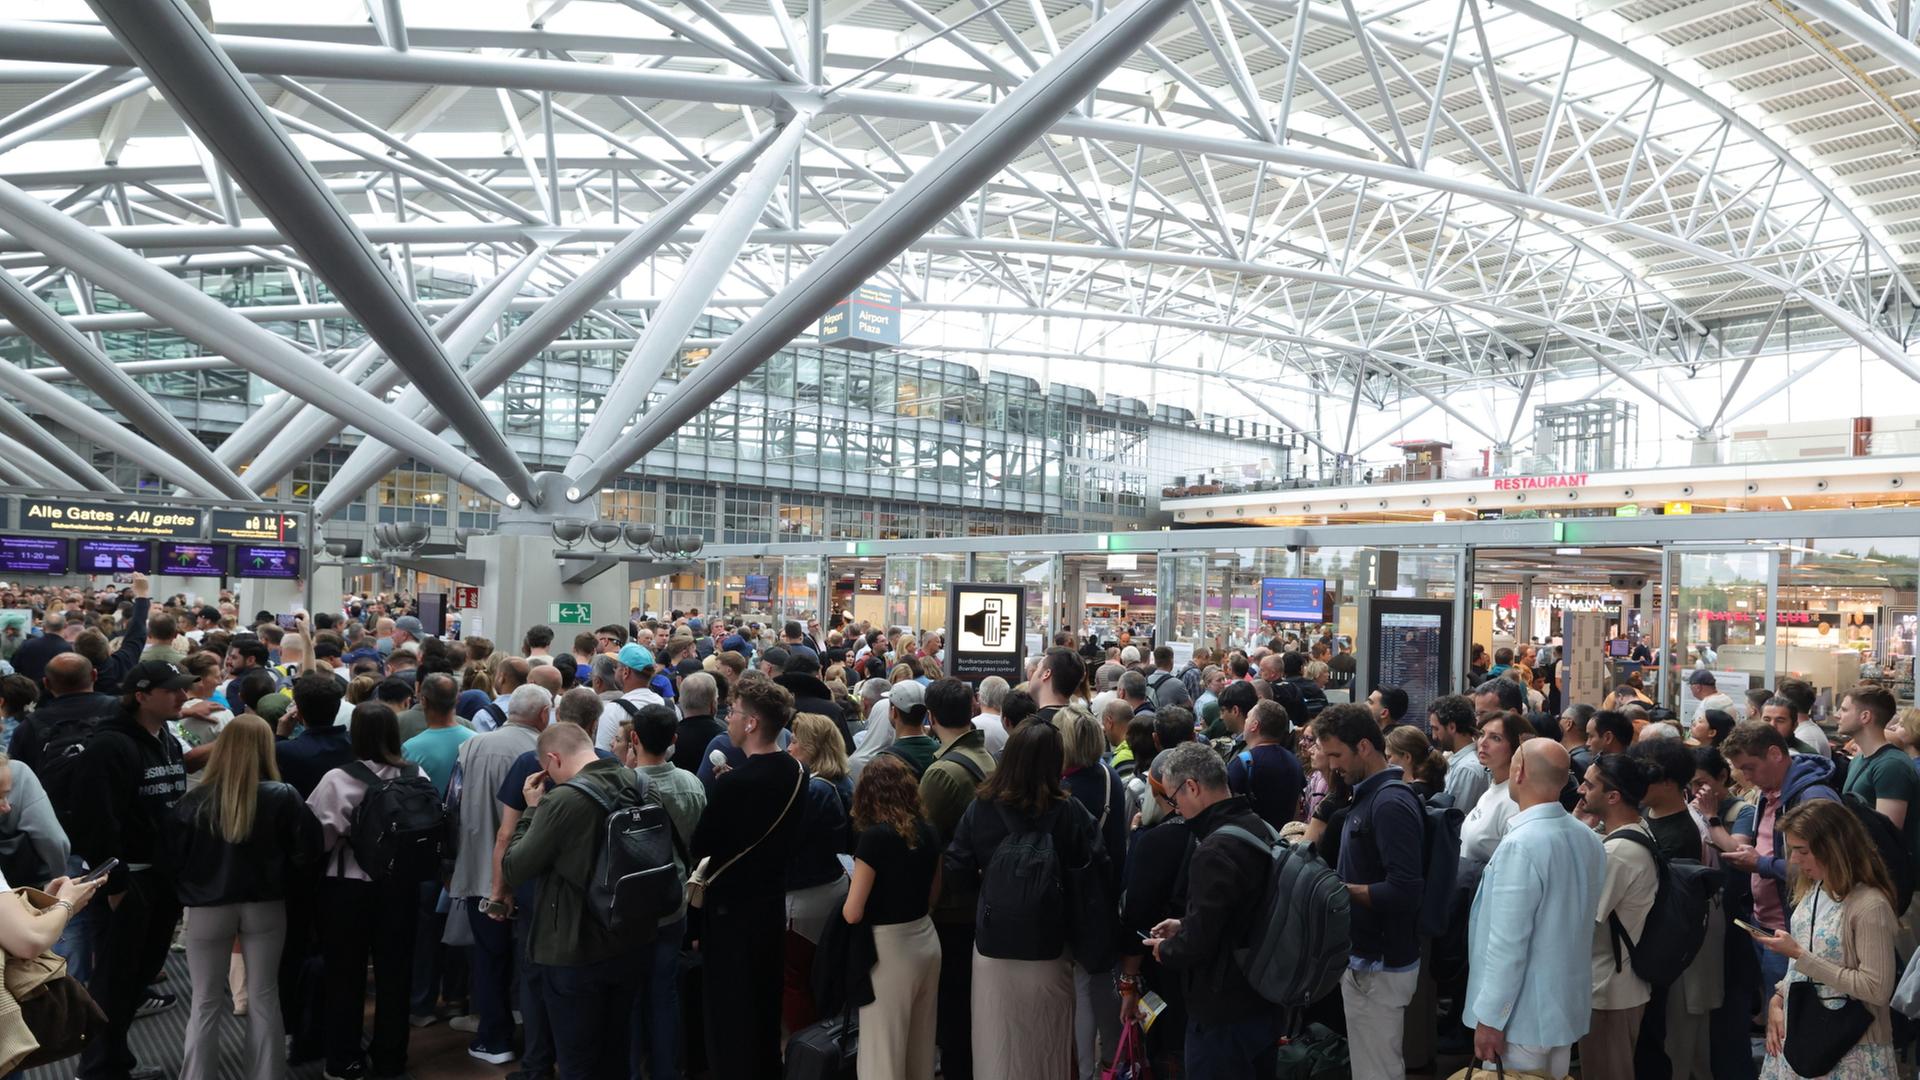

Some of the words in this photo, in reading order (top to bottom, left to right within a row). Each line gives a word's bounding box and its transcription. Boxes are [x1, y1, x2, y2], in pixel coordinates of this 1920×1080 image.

[824, 312, 843, 324] Airport
[859, 310, 889, 325] Airport
[823, 326, 838, 335] Plaza
[859, 322, 880, 334] Plaza
[1494, 474, 1588, 490] RESTAURANT
[28, 504, 62, 519] Alle
[66, 506, 115, 522] Gates
[126, 510, 150, 523] All
[152, 514, 195, 527] gates
